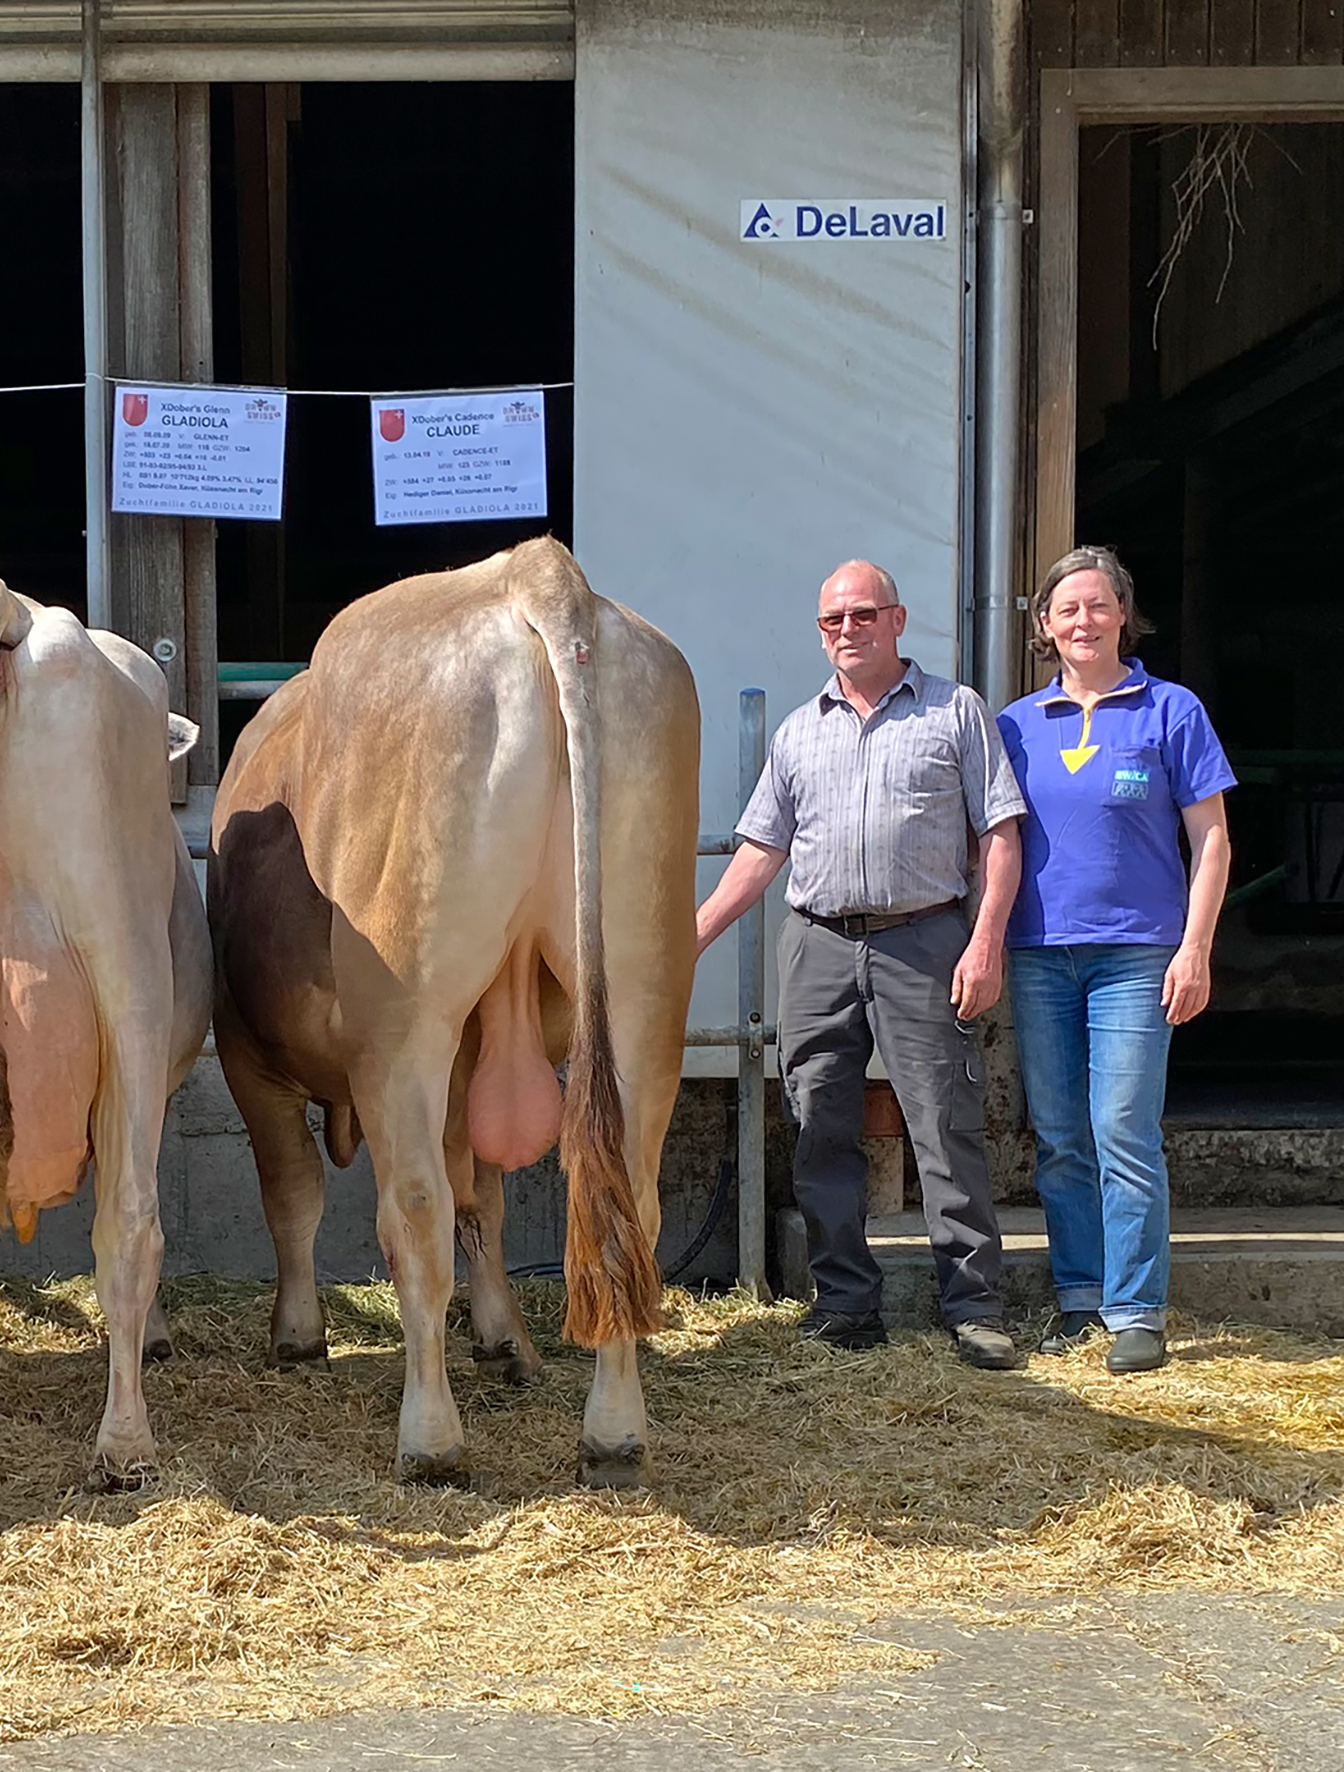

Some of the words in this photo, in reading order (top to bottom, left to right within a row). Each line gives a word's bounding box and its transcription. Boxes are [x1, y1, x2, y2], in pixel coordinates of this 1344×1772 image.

[796, 205, 944, 237] DeLaval
[161, 403, 201, 413] XDober's
[204, 405, 230, 414] Glenn
[162, 415, 228, 428] GLADIOLA
[412, 414, 452, 424] XDober's
[455, 412, 494, 422] Cadence
[194, 433, 229, 441] GLENN-ET
[427, 424, 480, 437] CLAUDE
[453, 447, 498, 456] CADENCE-ET
[119, 498, 185, 508] Zuchtfamilie
[190, 500, 245, 511] GLADIOLA
[249, 504, 272, 512] 2021
[384, 509, 450, 518] Zuchtfamilie
[455, 504, 510, 514] GLADIOLA
[515, 503, 539, 511] 2021
